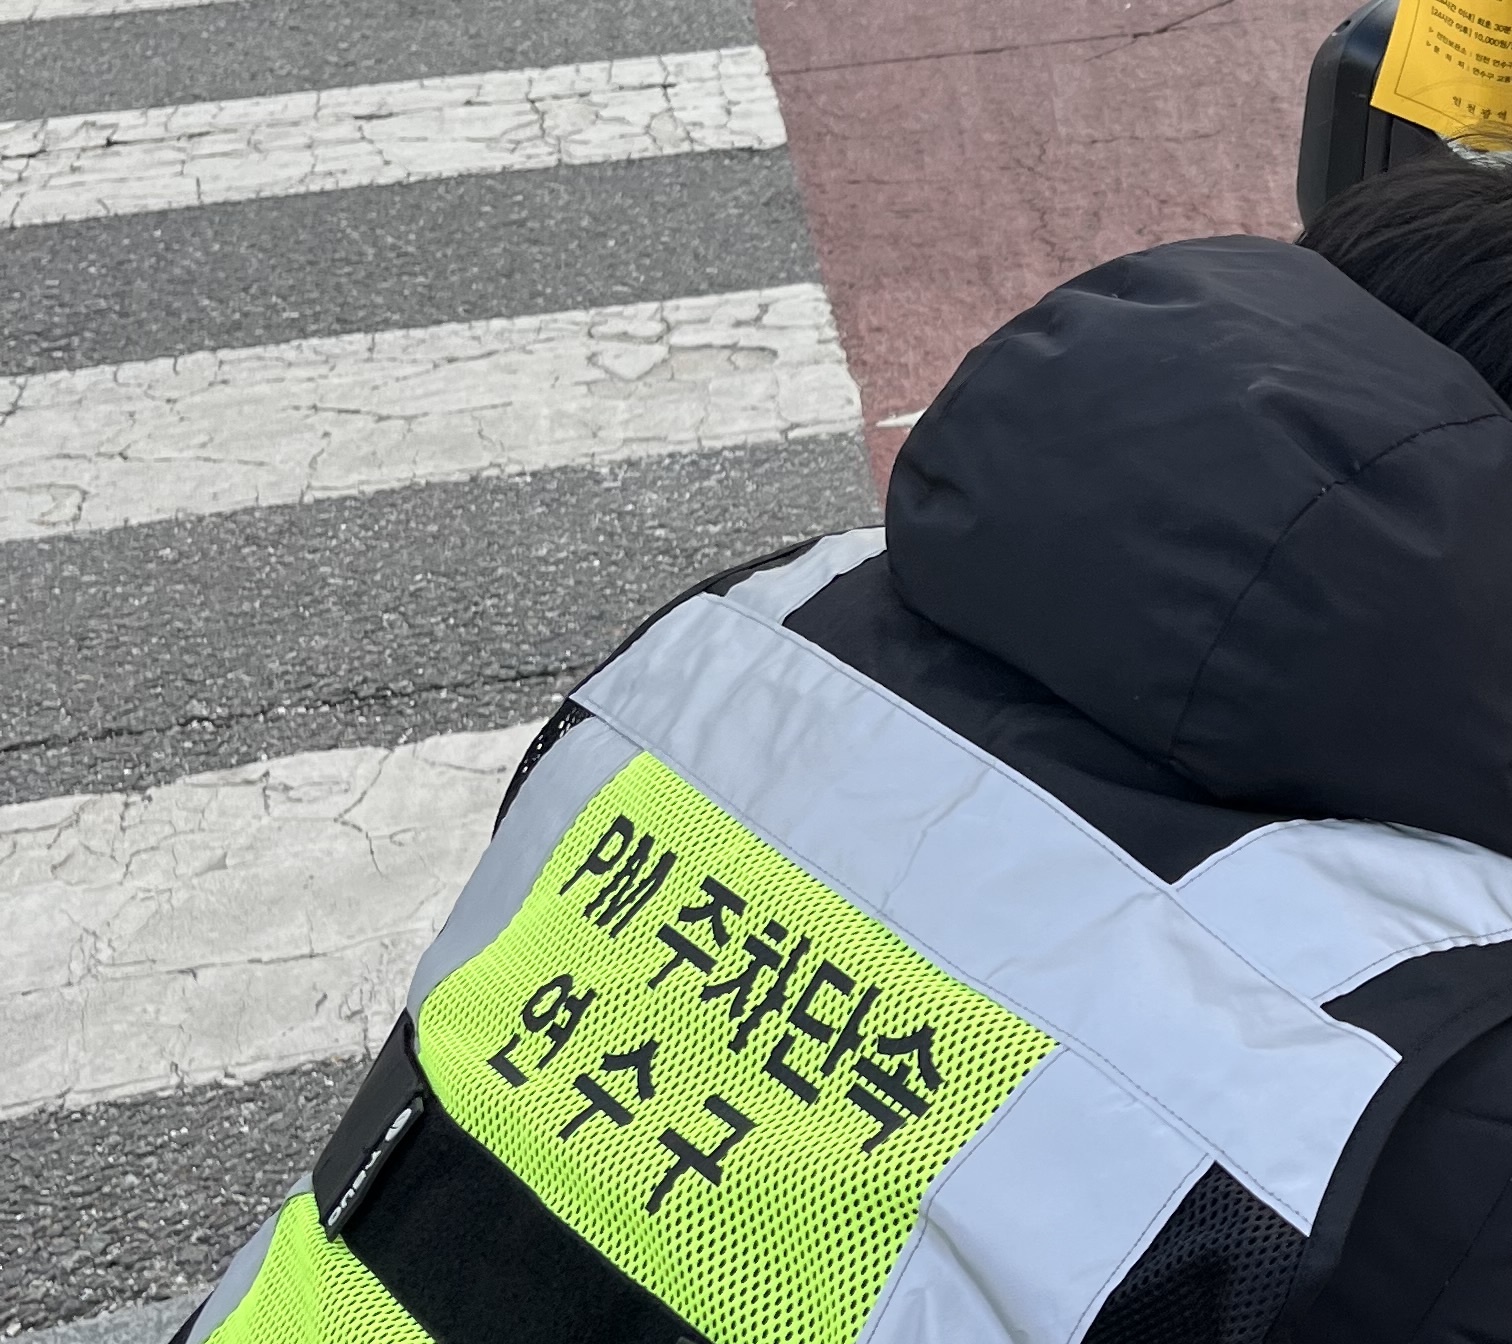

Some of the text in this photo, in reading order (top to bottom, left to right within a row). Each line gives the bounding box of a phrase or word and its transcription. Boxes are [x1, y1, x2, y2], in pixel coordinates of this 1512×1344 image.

[487, 973, 755, 1214] 연수구
[560, 814, 947, 1155] PM 주차단속
